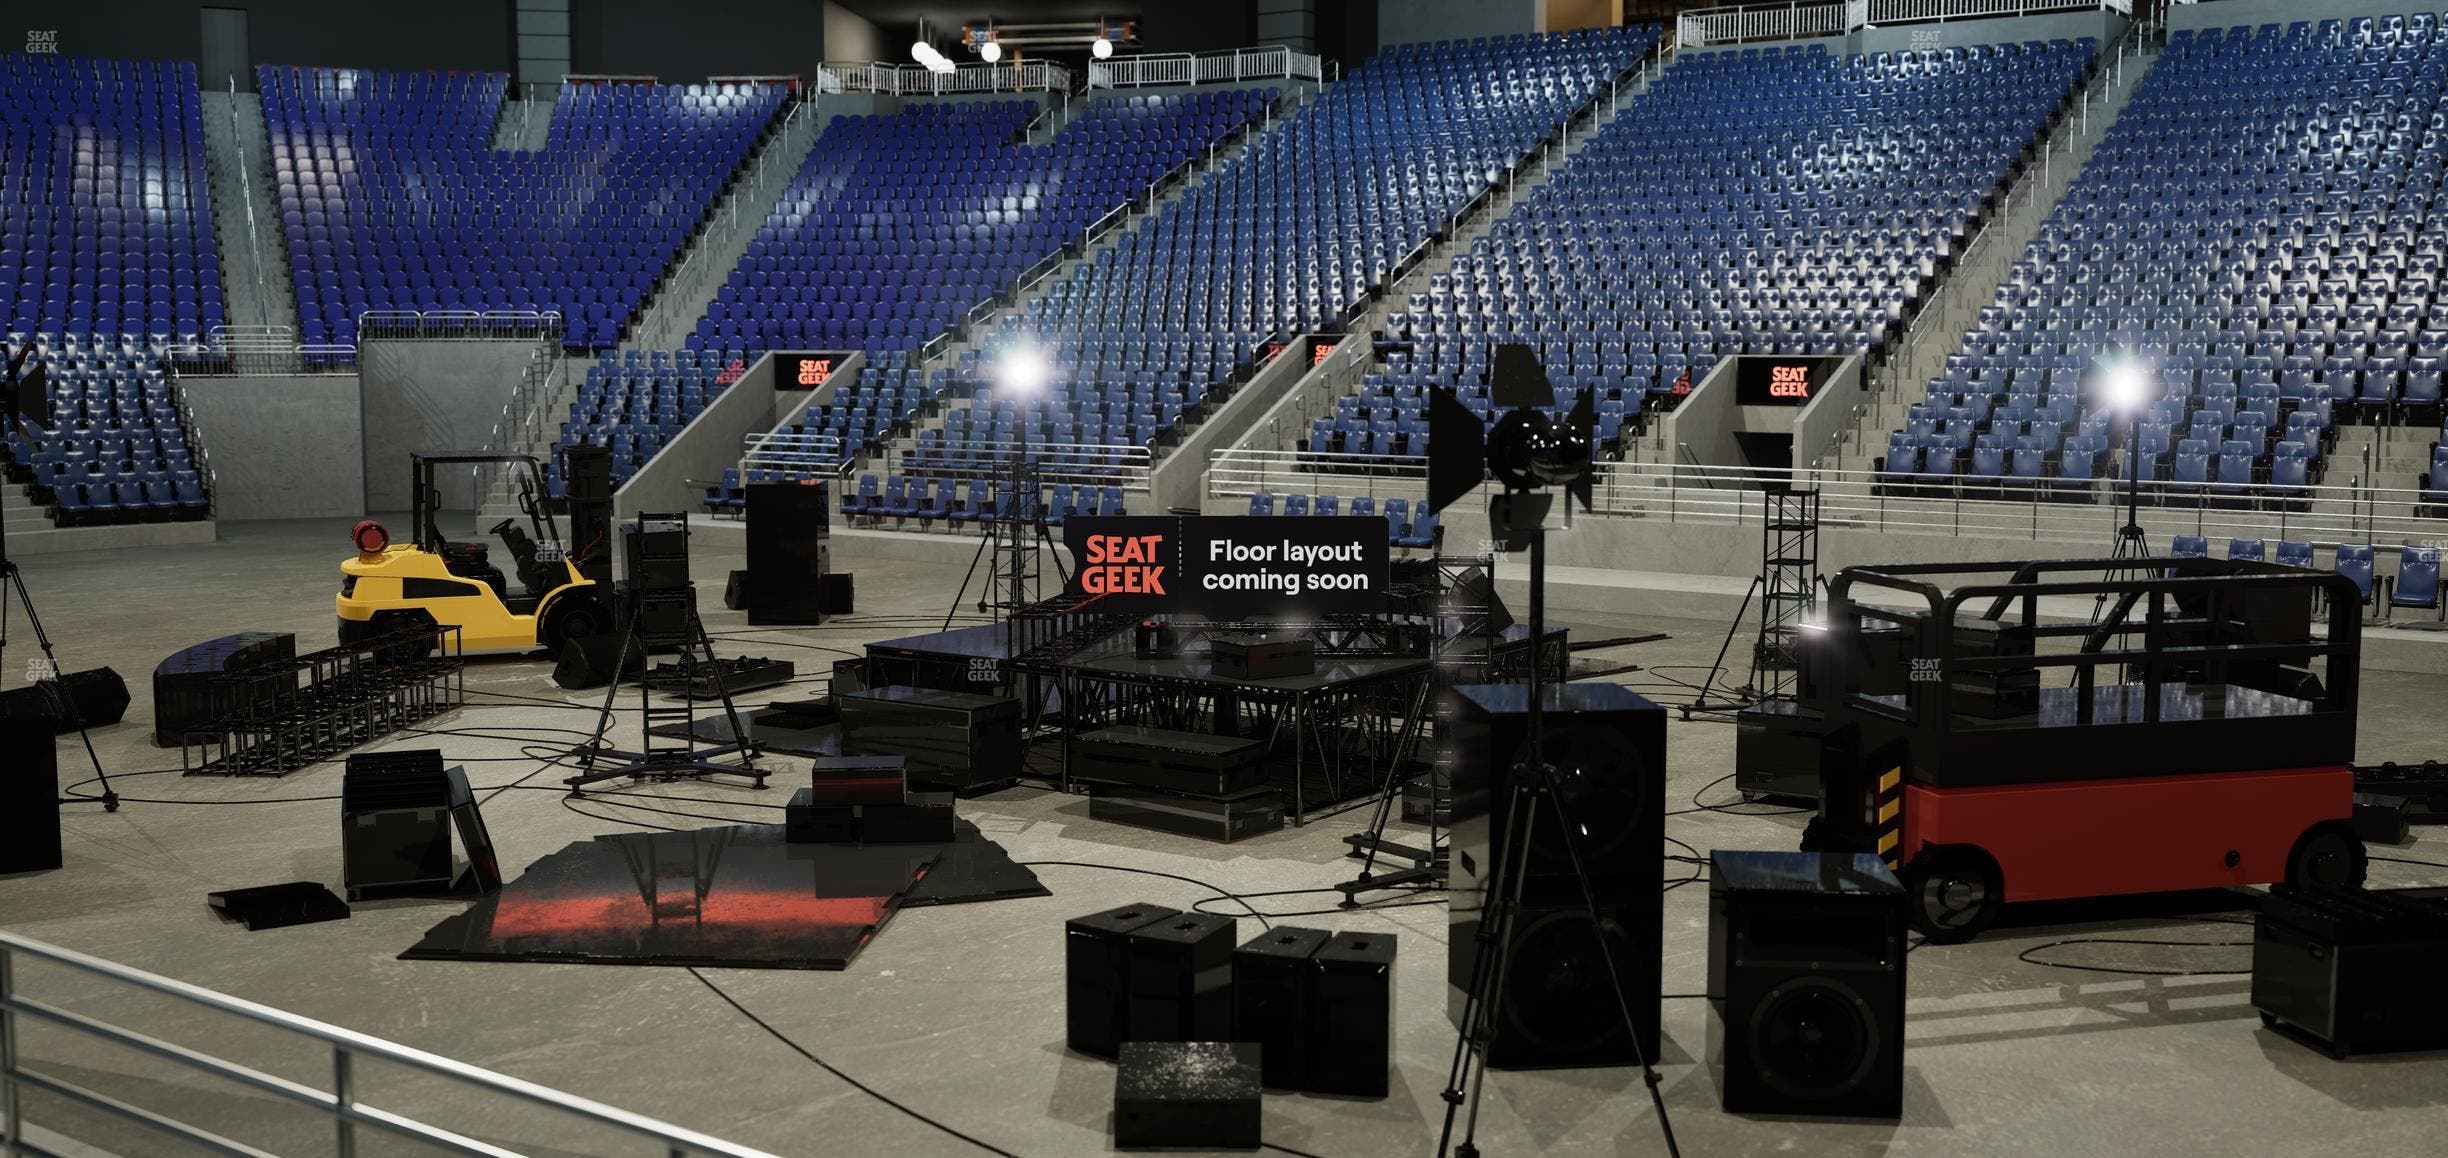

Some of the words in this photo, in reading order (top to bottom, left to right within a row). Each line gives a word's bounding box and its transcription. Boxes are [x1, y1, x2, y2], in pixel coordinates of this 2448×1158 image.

[800, 360, 830, 372] SEAT
[1772, 366, 1808, 382] SEAT
[1770, 382, 1809, 397] GEEK
[1086, 534, 1163, 563] SEAT
[1210, 539, 1276, 561] Floor
[1283, 539, 1363, 567] layout
[1081, 565, 1166, 595] GEEK
[1203, 568, 1301, 595] coming
[1306, 573, 1368, 590] soon
